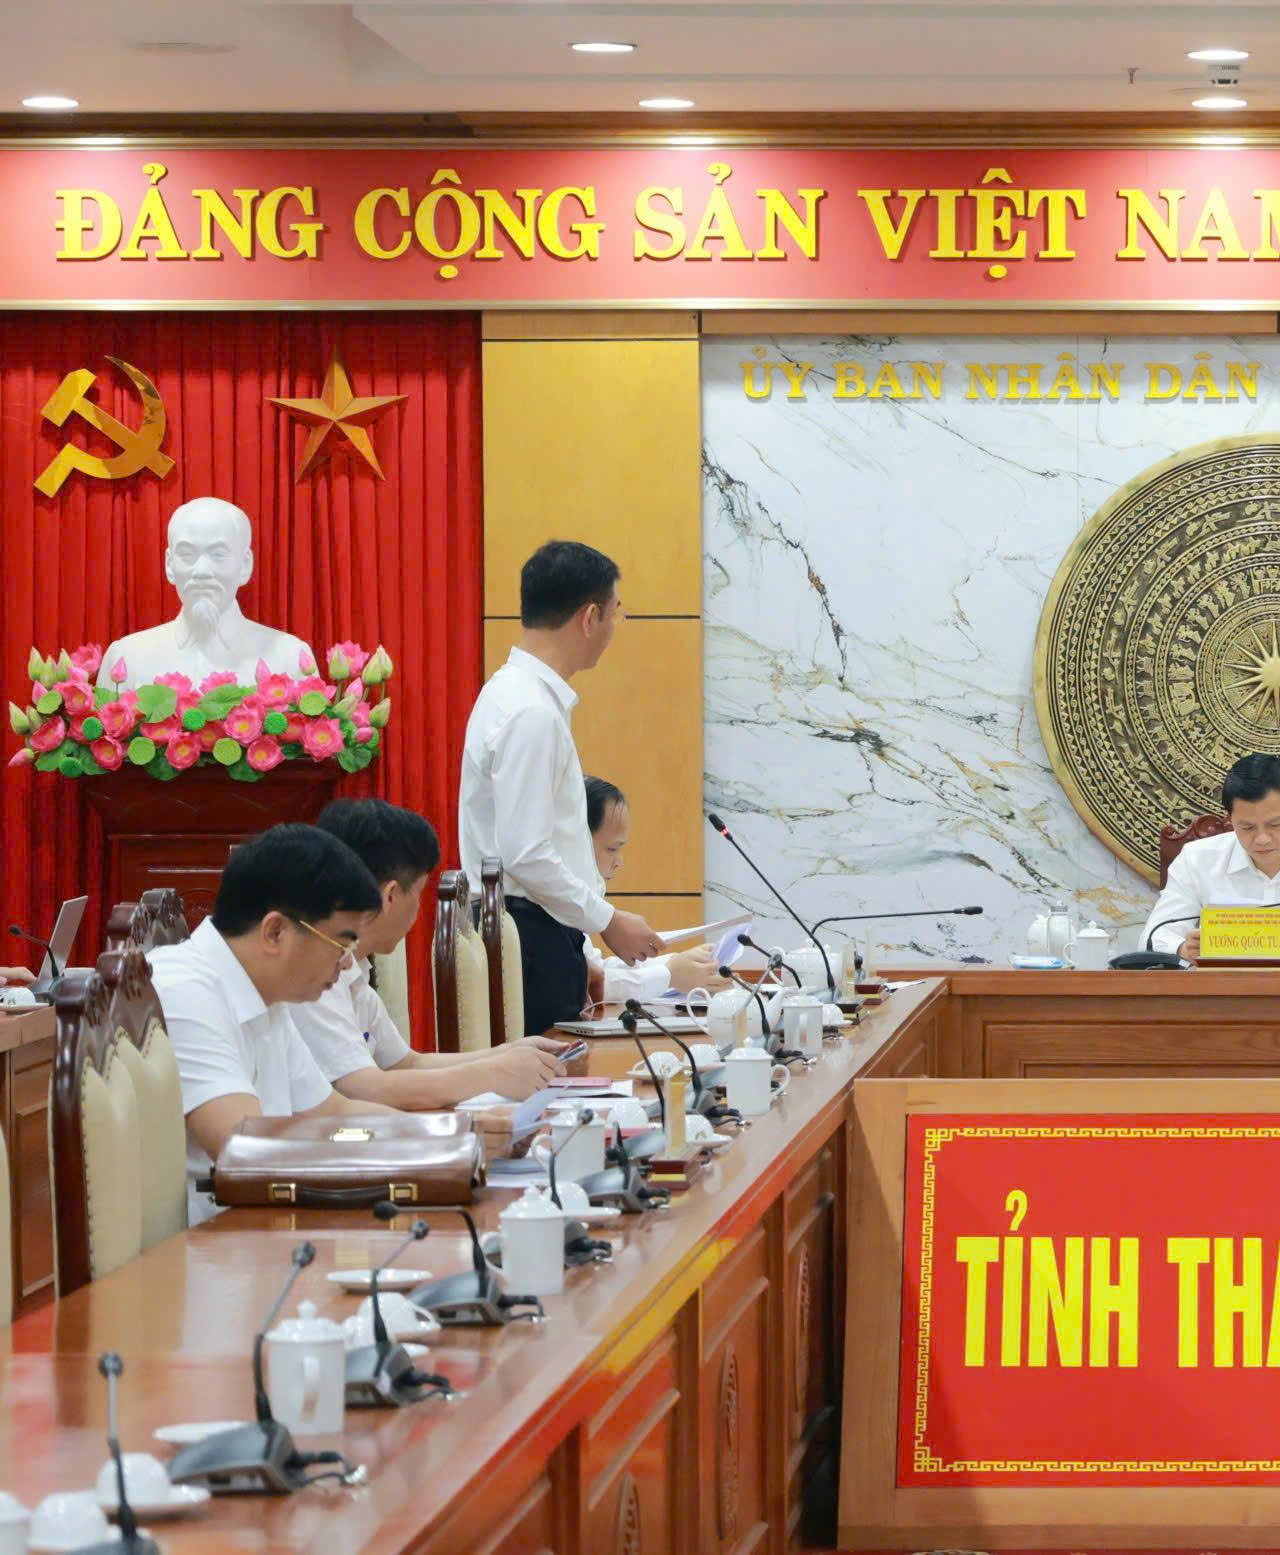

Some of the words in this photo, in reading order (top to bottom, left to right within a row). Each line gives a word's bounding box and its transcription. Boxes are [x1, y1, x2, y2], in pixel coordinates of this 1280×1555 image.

[55, 163, 323, 260] ĐẢNG
[353, 169, 605, 278] CỘNG
[633, 162, 824, 260] SẢN
[857, 168, 1087, 279] VIỆT
[740, 346, 815, 401] ỦY
[832, 362, 945, 401] BAN
[964, 352, 1122, 401] NHÂN
[1144, 352, 1261, 401] DÂN
[955, 1189, 1139, 1369] TỈNH
